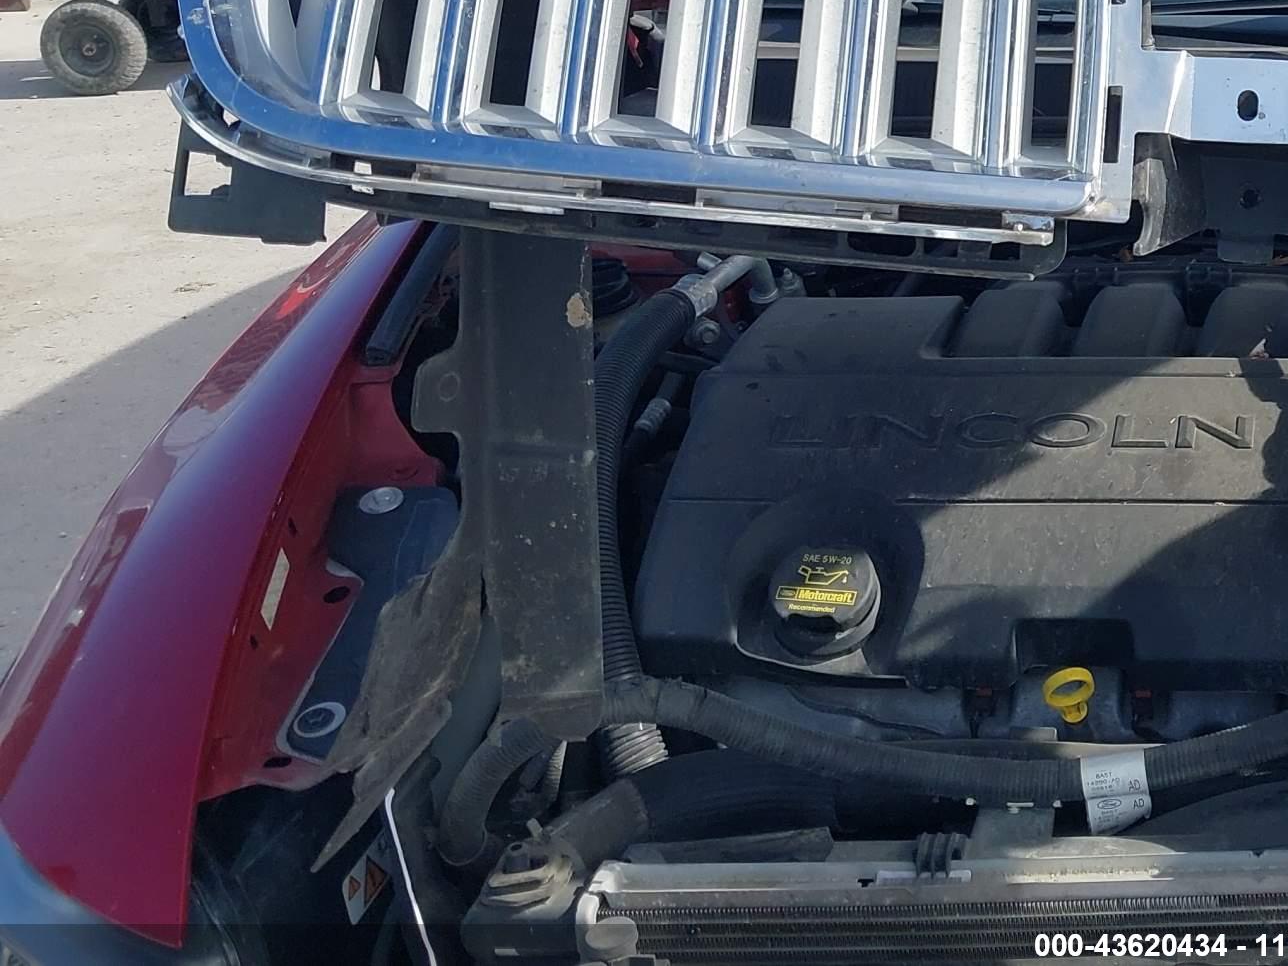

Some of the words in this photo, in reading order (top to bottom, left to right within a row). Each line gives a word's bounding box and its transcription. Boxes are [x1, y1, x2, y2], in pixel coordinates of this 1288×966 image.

[770, 413, 1256, 449] LINCOLN
[803, 553, 821, 563] SAE
[822, 555, 852, 565] 5W-20
[798, 589, 853, 603] Motorcraft
[788, 603, 836, 613] Recommended
[1128, 778, 1141, 792] AD
[1133, 797, 1145, 810] AD
